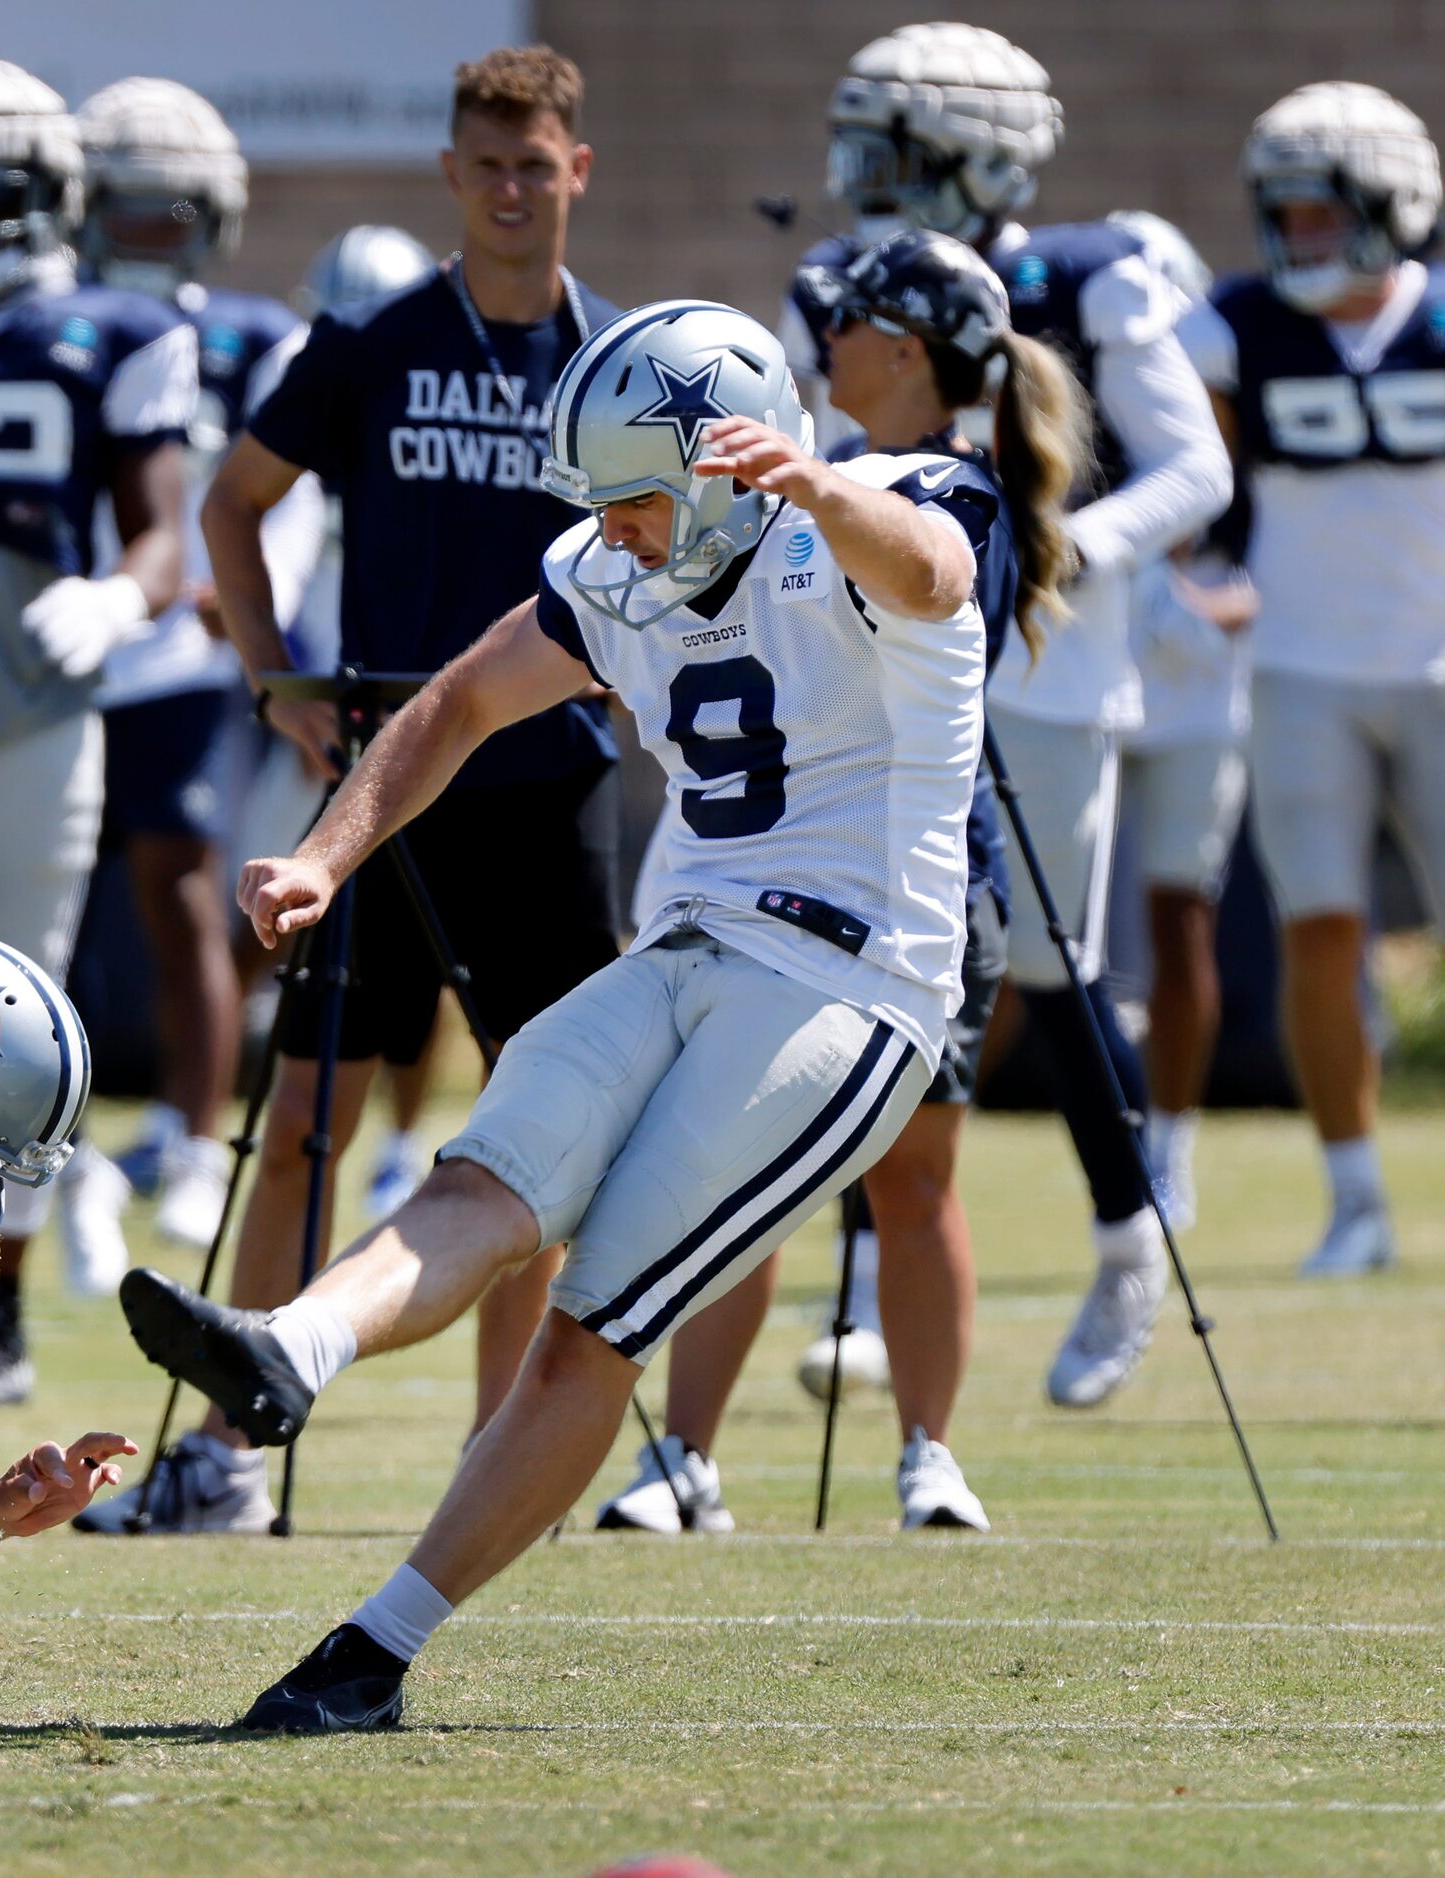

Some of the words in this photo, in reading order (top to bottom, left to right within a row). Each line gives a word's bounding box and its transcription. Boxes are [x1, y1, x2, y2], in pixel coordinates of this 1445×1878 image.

[406, 369, 554, 431] DALL
[389, 426, 546, 492] COWBO
[781, 572, 815, 592] AT&T
[682, 623, 746, 648] COWBOYS
[666, 654, 790, 838] 9
